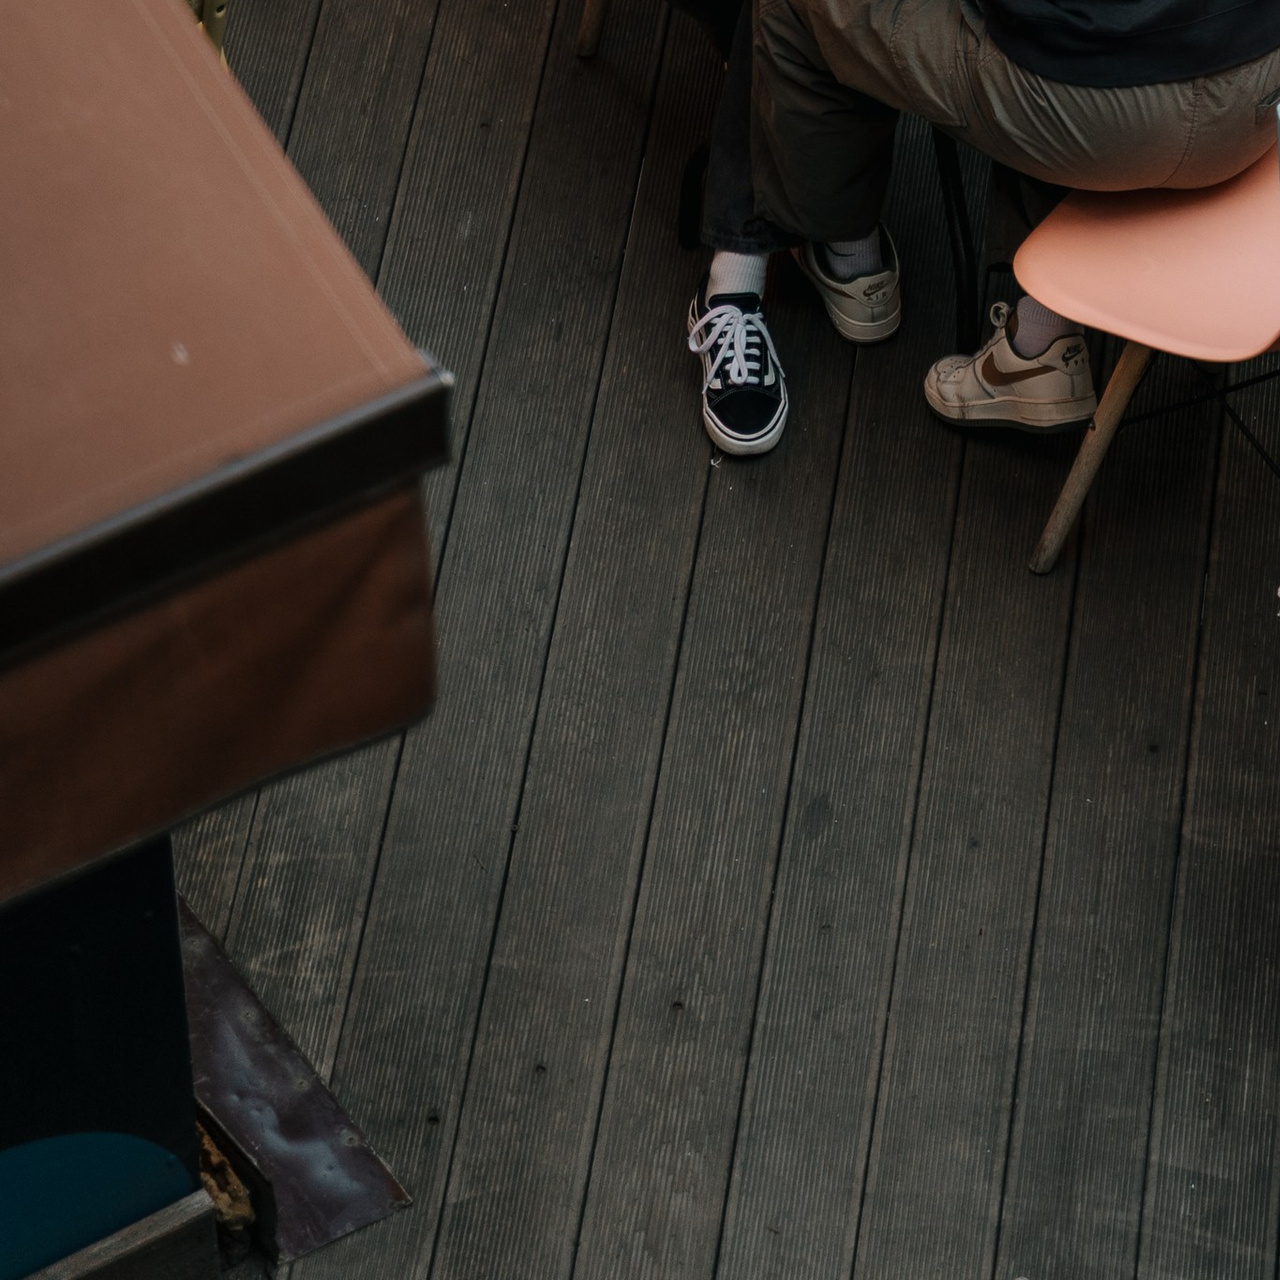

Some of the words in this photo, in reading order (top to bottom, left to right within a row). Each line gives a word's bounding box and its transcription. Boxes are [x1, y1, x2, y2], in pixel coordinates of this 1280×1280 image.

[867, 280, 886, 291] NIKE
[867, 291, 887, 301] AIR
[1065, 344, 1081, 355] NIKE
